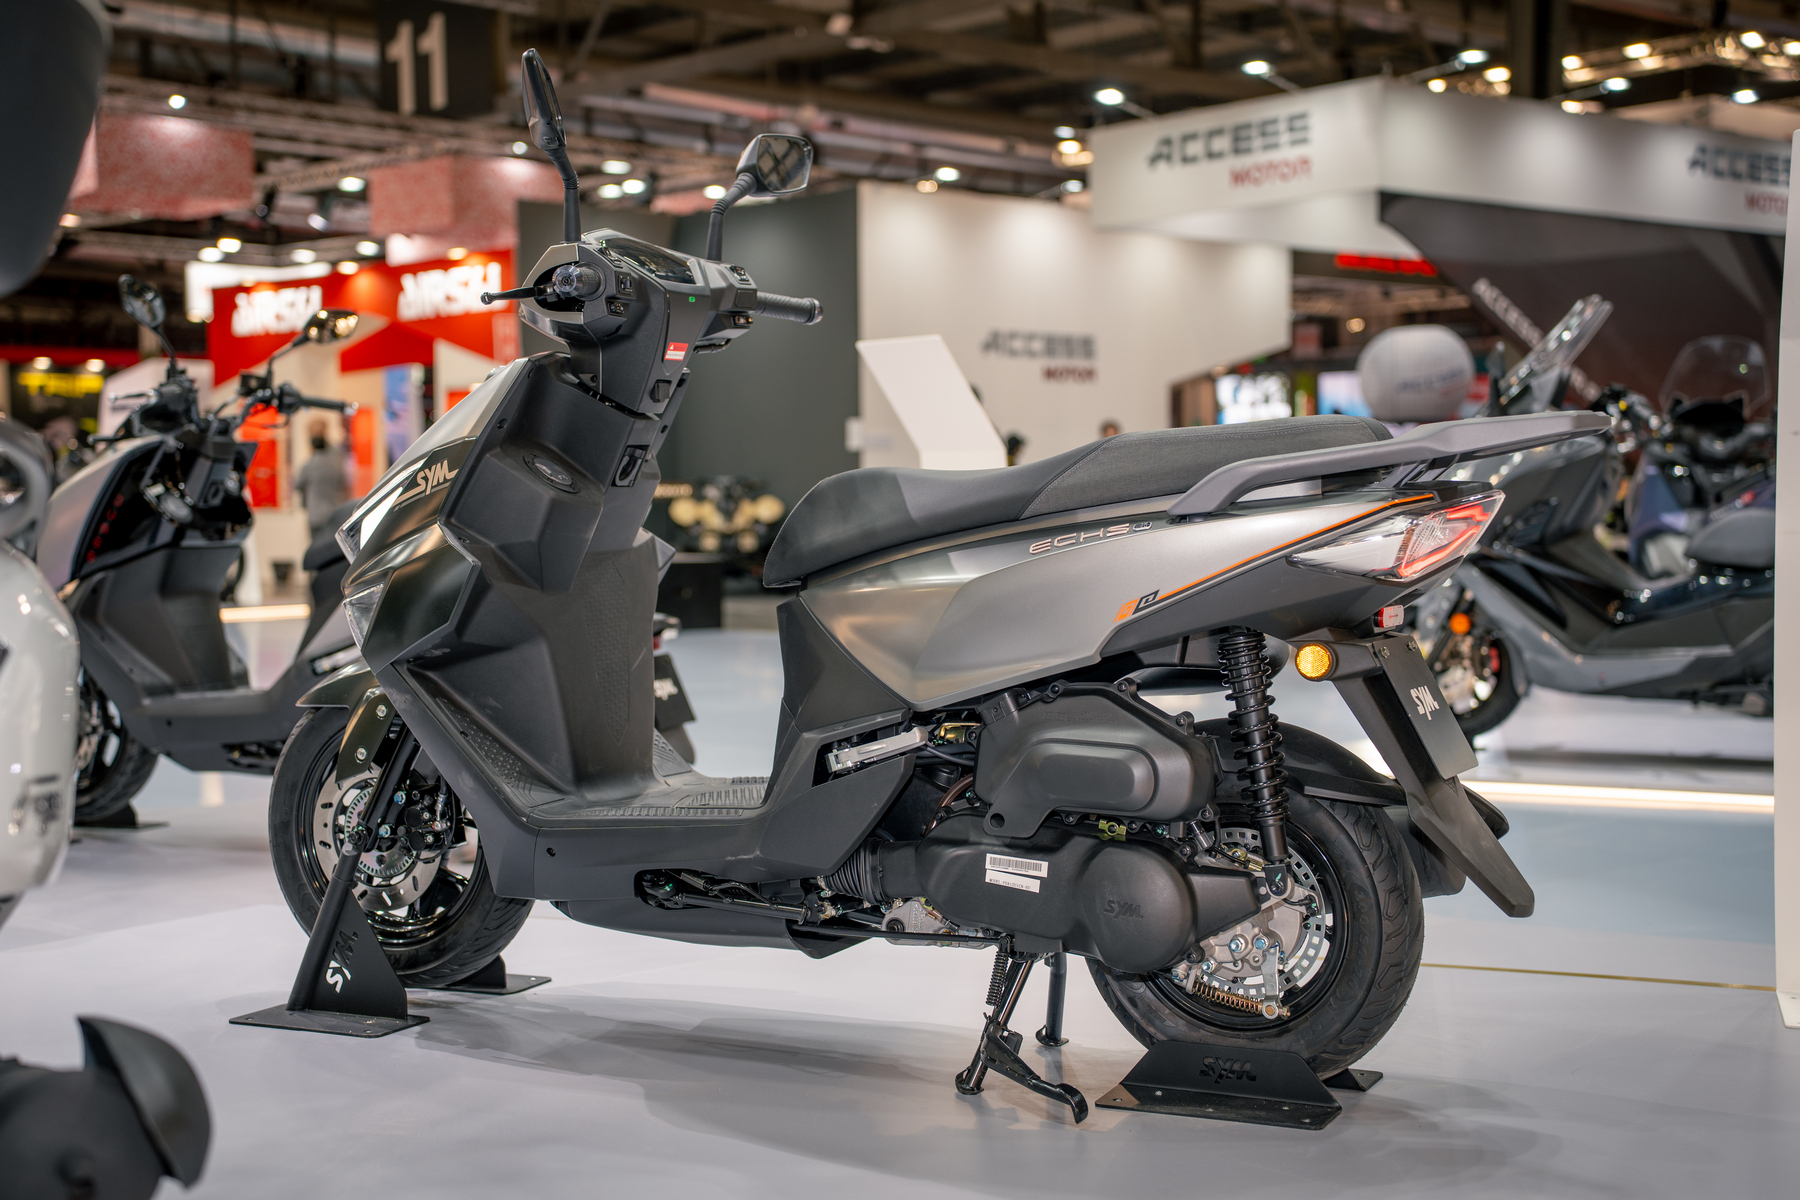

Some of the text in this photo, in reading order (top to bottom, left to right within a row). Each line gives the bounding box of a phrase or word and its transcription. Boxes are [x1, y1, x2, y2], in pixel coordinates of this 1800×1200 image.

[384, 11, 448, 116] 11
[1147, 110, 1310, 172] ACCESS
[1229, 154, 1312, 190] MOTOR
[1744, 191, 1788, 216] MOTO
[395, 459, 459, 504] SYM
[1409, 685, 1440, 721] SYM
[1103, 899, 1145, 919] SYM
[1199, 1056, 1257, 1084] SYM
